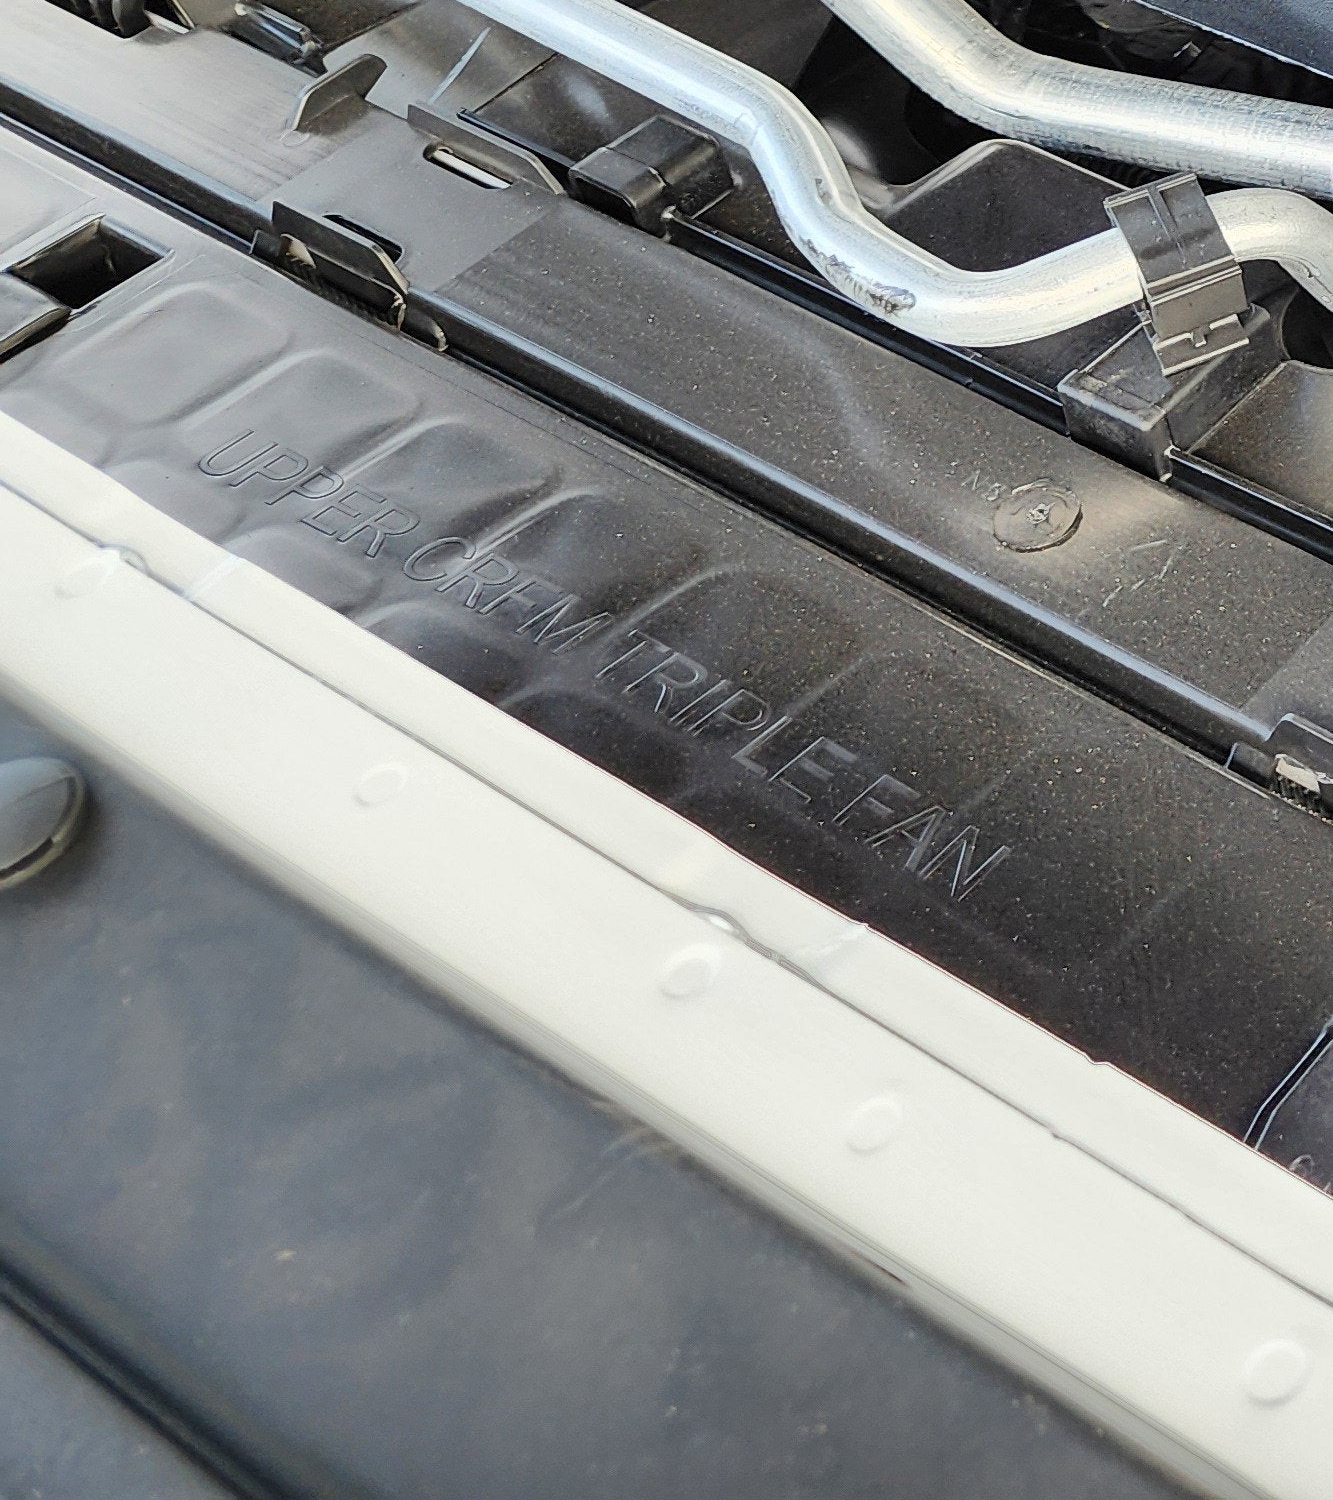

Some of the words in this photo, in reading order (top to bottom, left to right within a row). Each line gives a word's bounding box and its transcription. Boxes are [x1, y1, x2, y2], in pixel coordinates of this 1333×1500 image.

[198, 428, 421, 558] UPPER
[402, 536, 613, 656] CRFM
[596, 628, 859, 804] TRIPLE
[831, 773, 1013, 902] FAN
